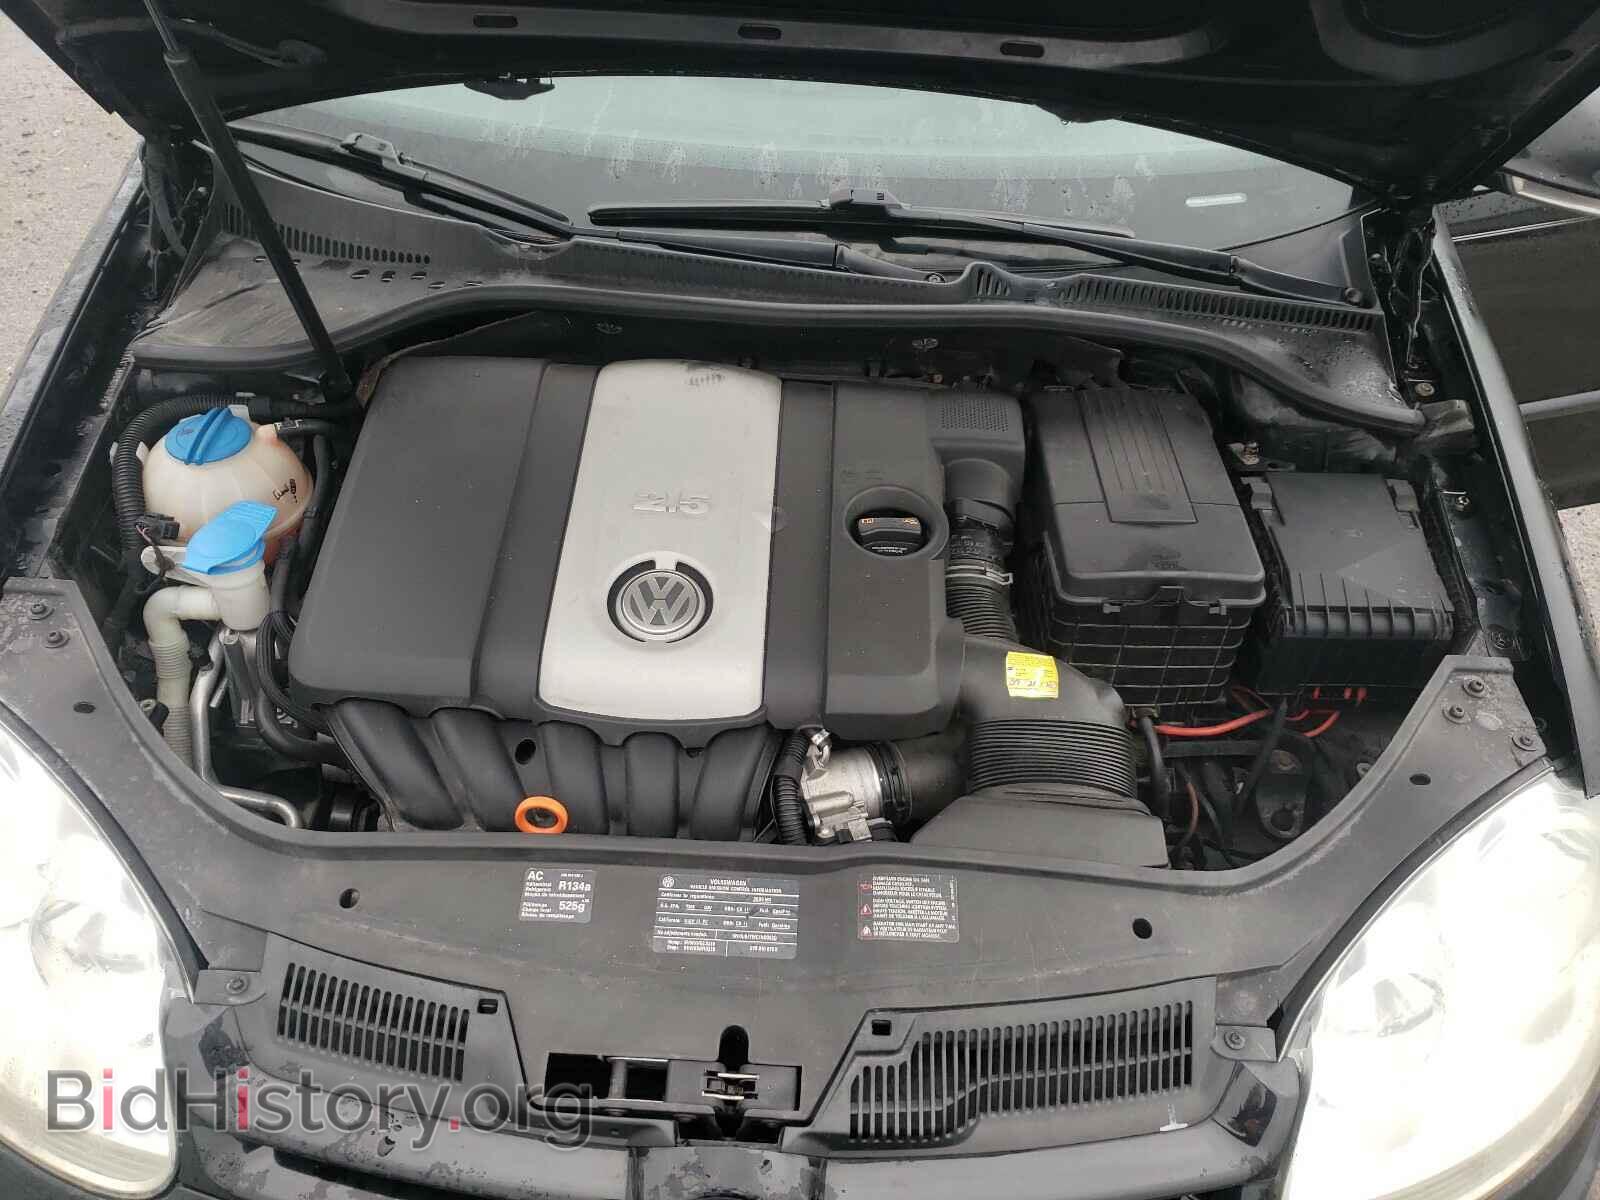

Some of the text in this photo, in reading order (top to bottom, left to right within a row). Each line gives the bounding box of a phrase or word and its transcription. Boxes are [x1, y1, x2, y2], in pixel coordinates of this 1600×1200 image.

[527, 870, 544, 881] AC
[558, 880, 592, 892] R134a
[558, 900, 586, 913] 525g
